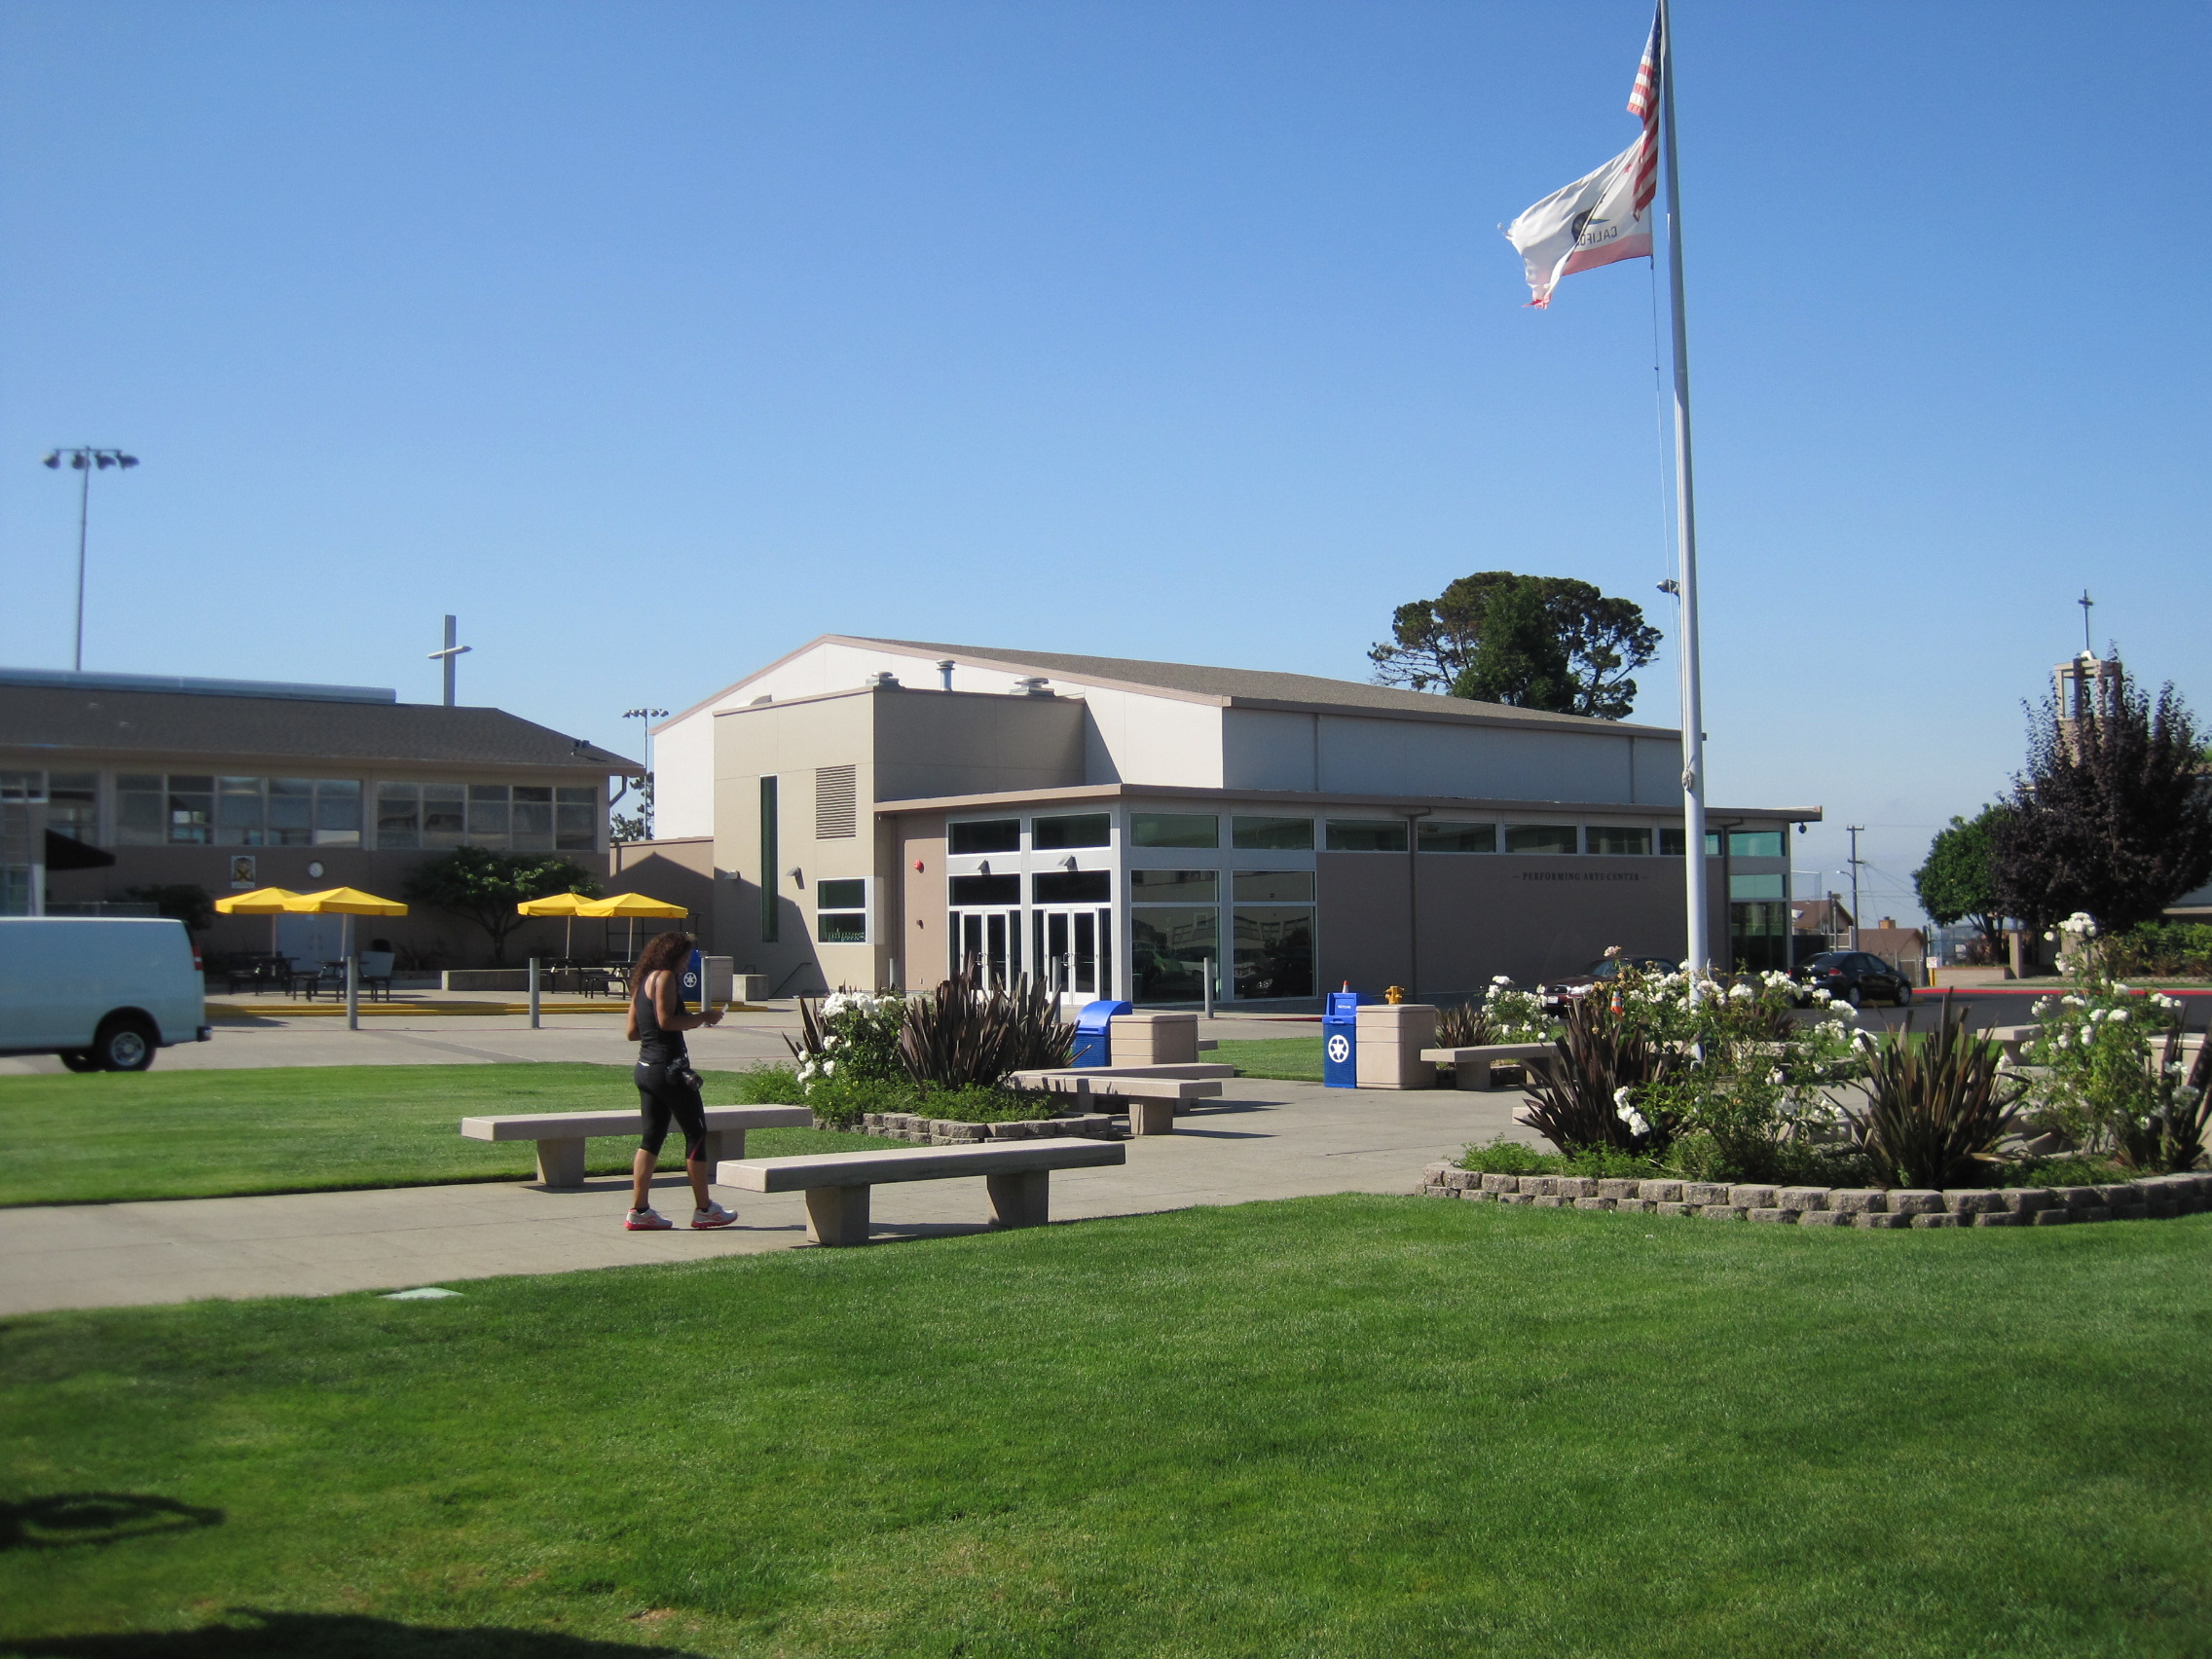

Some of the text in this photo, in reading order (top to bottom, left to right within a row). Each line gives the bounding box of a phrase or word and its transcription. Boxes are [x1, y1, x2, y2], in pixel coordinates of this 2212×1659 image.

[1523, 871, 1640, 881] PERFORMING ARTS CENTER
